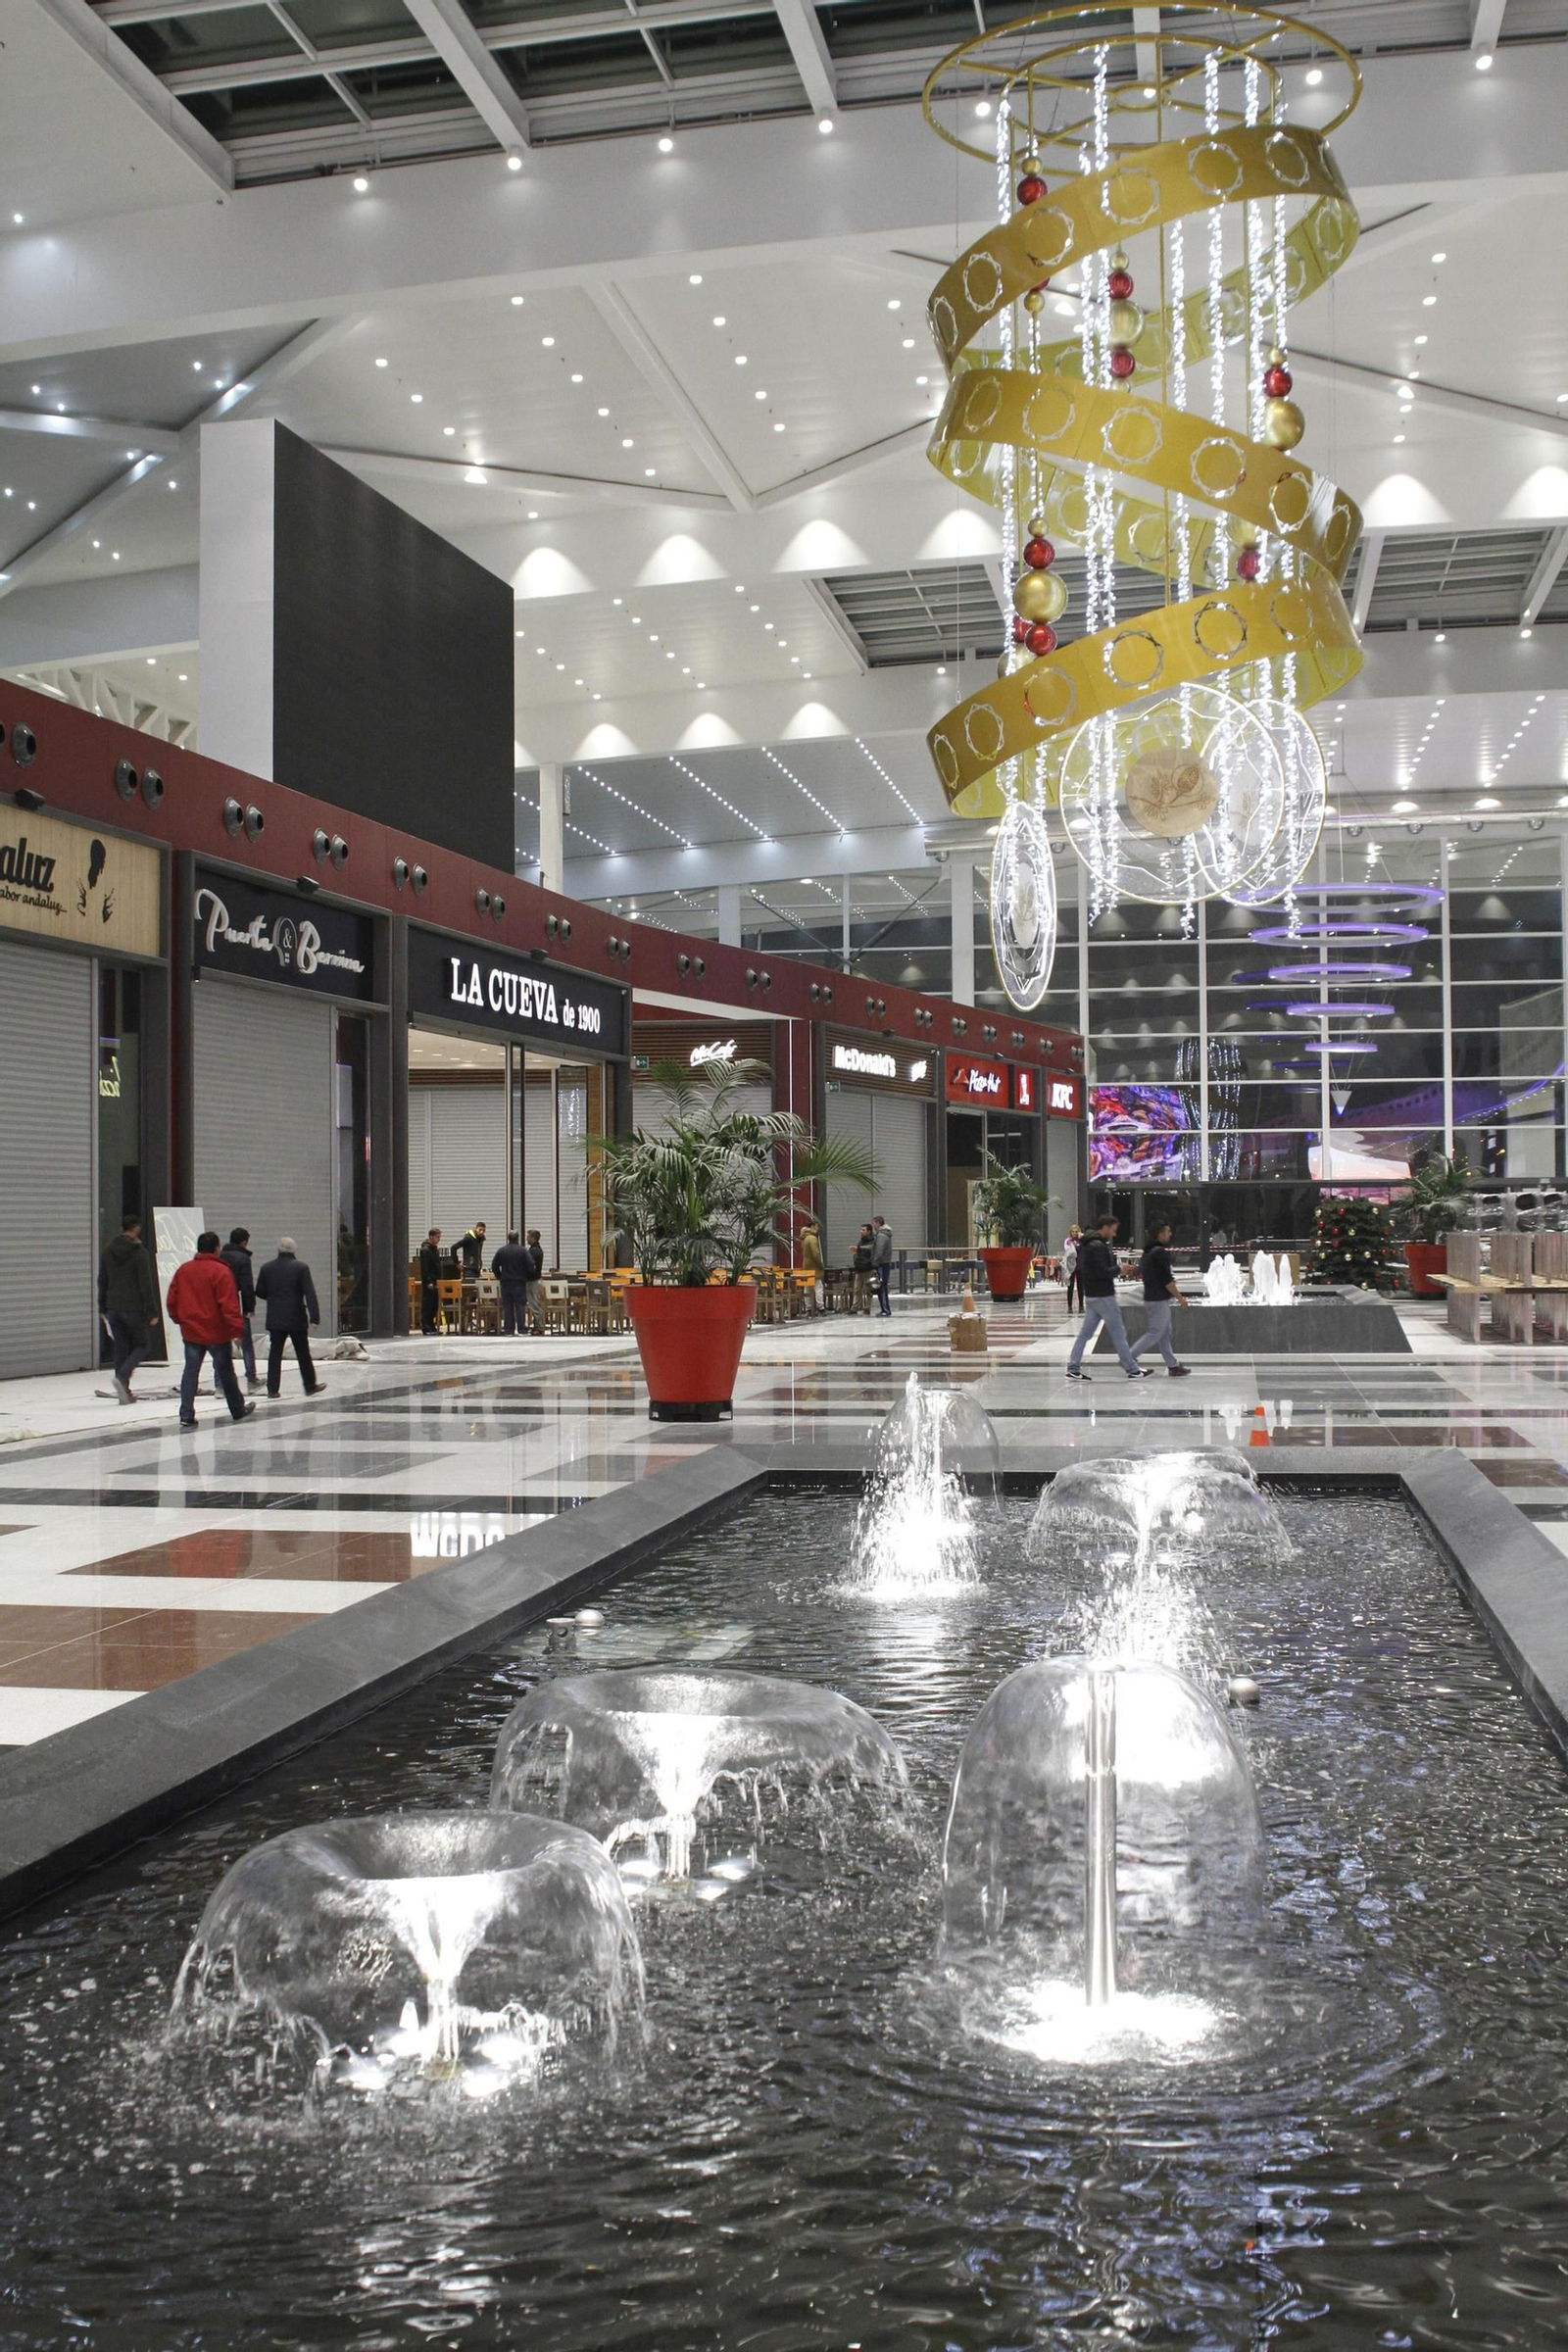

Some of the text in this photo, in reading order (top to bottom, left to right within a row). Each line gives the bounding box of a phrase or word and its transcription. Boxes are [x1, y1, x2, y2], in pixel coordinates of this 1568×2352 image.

[194, 888, 274, 953] Puerta
[451, 957, 601, 1034] LA CUEVA de 1900
[834, 1045, 897, 1078] McDonald's
[1052, 1082, 1074, 1110] KFC
